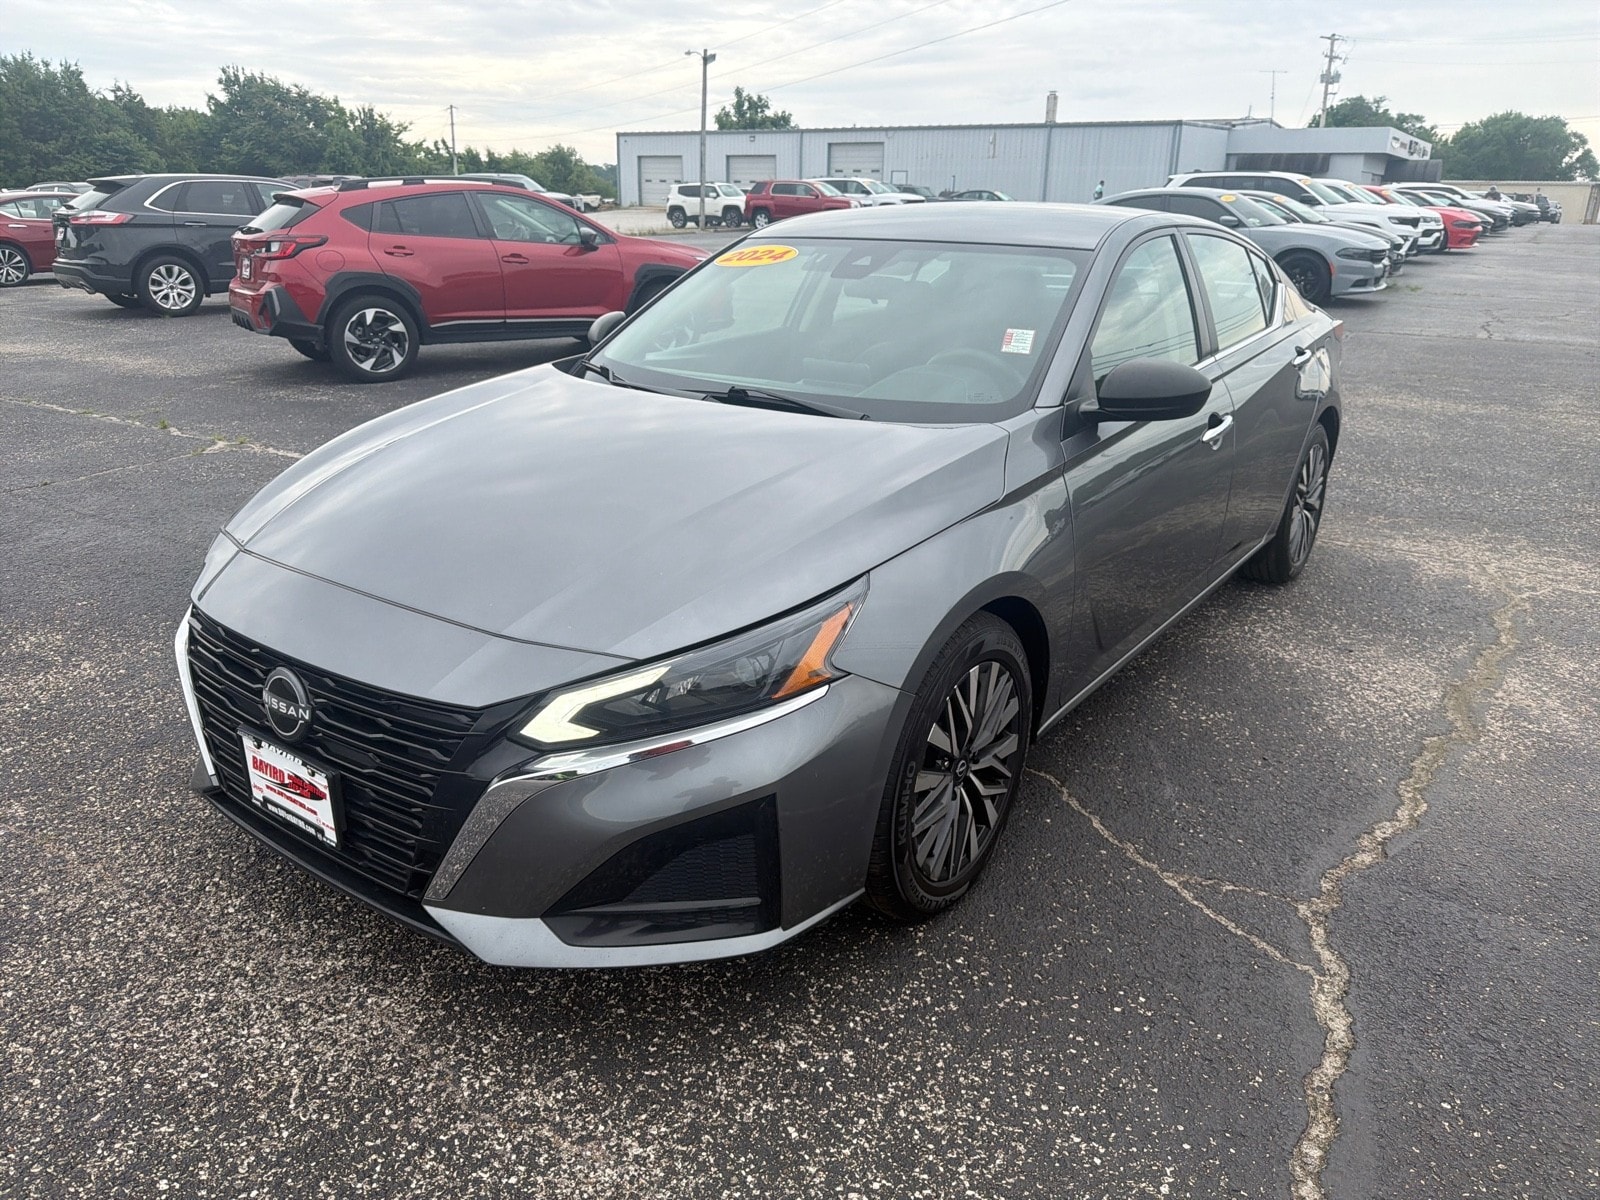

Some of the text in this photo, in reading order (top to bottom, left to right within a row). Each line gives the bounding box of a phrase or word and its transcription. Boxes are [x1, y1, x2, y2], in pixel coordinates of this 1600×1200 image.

[719, 249, 793, 263] 2024
[262, 692, 310, 720] NISSAN
[252, 755, 286, 784] BAYIRD
[897, 760, 916, 846] KUMHO
